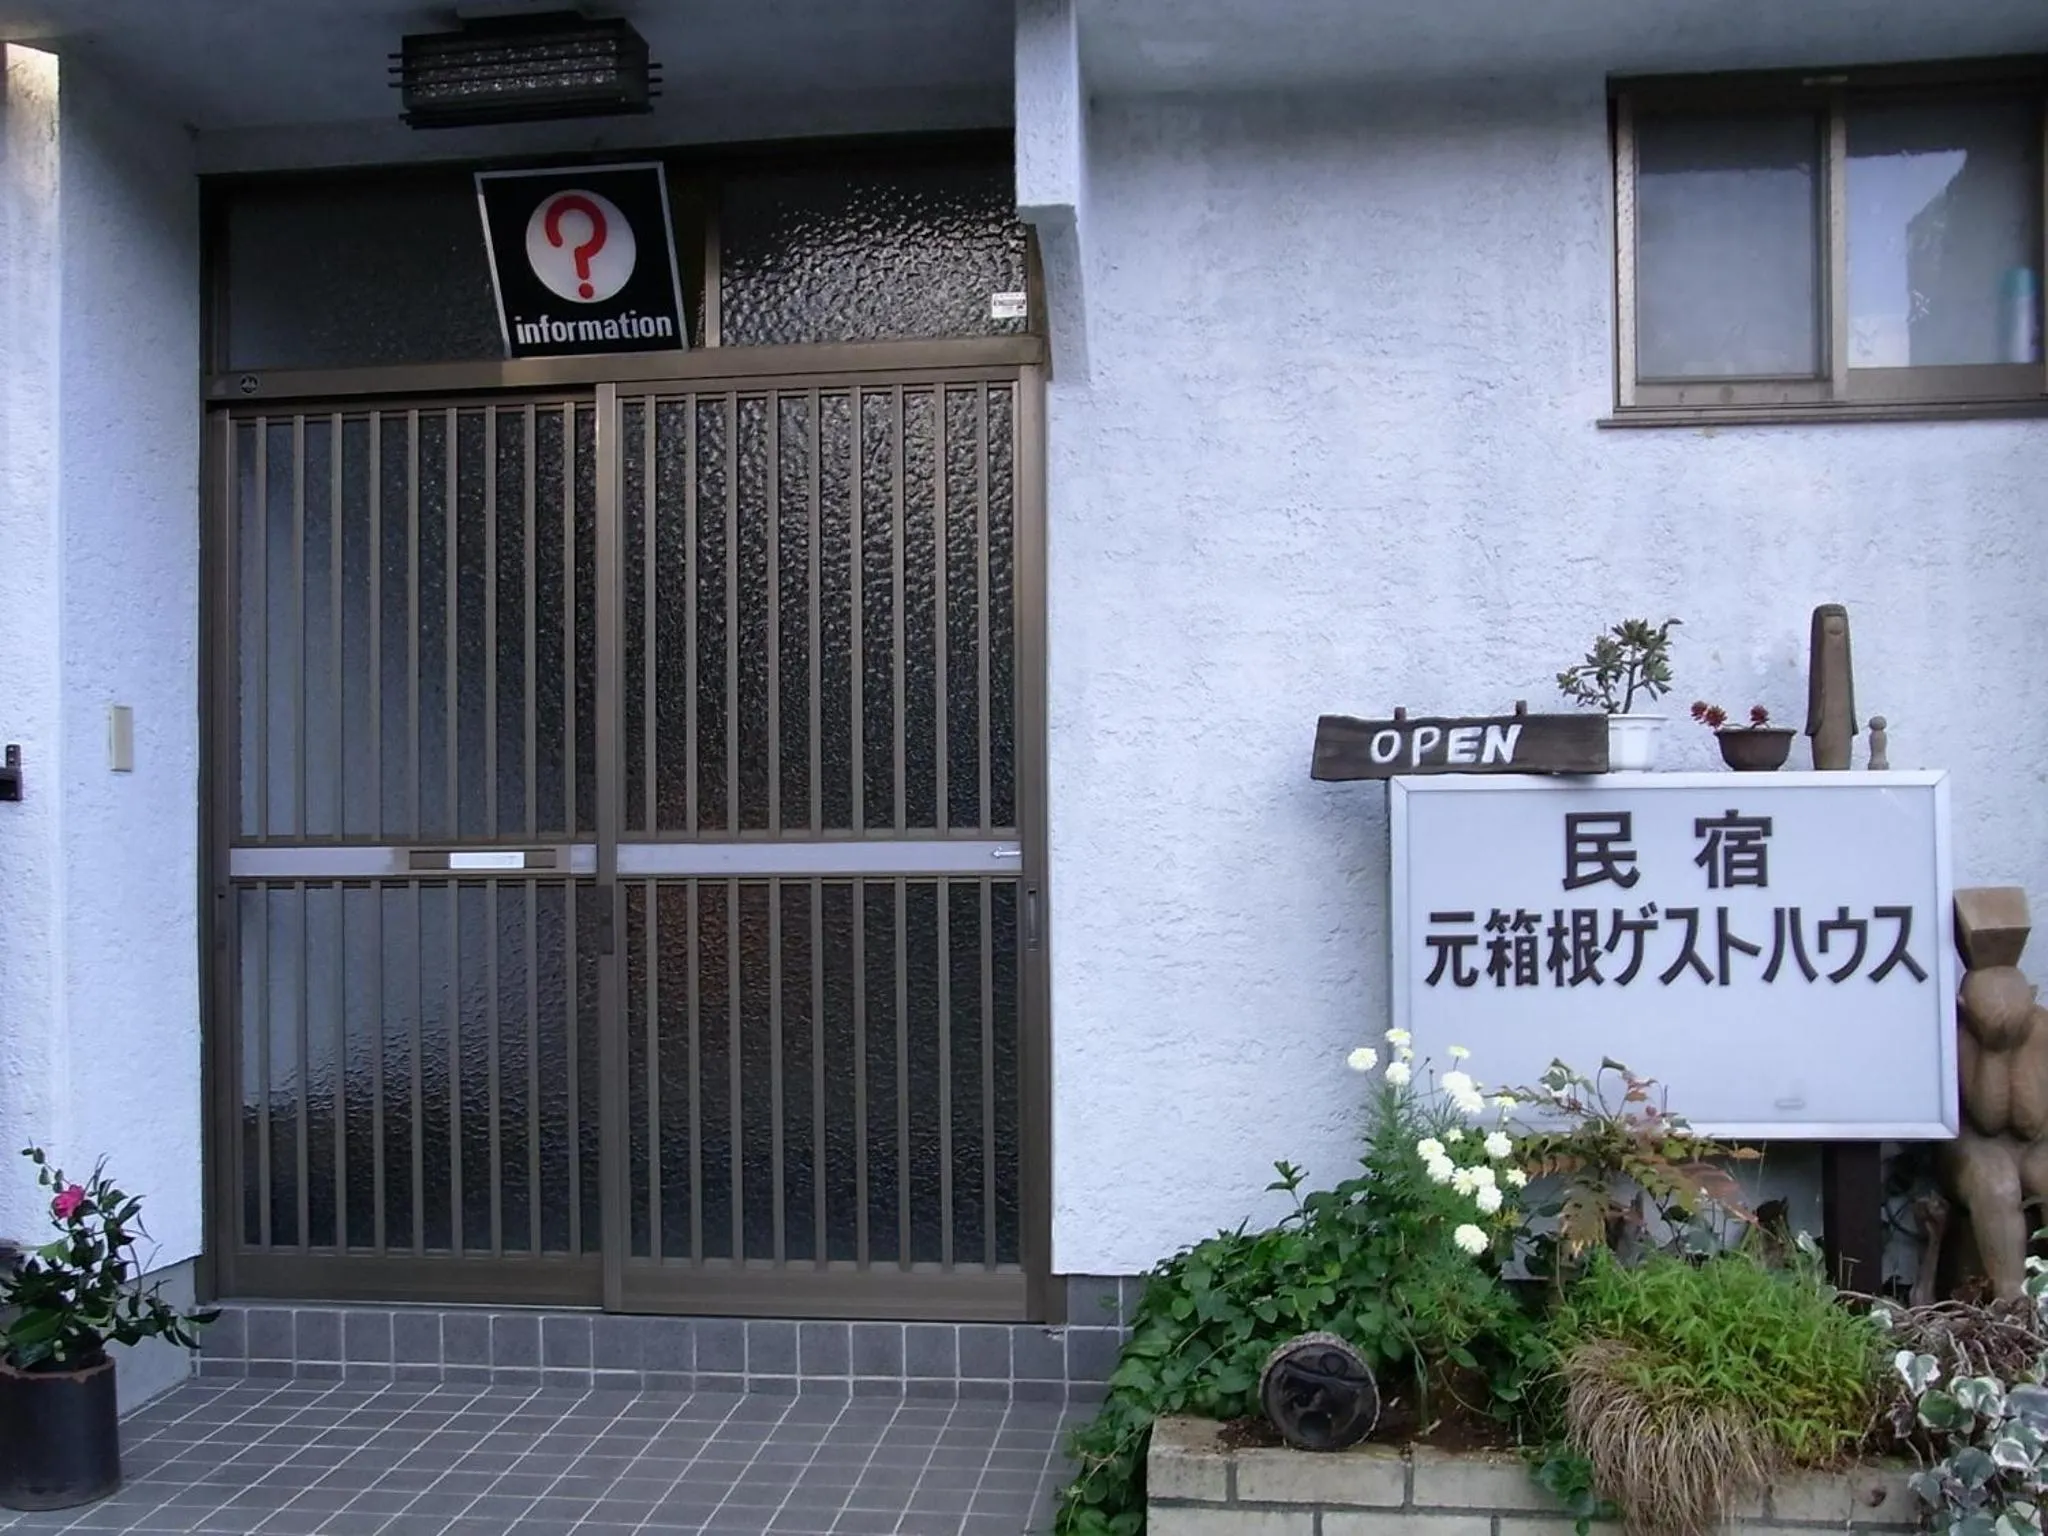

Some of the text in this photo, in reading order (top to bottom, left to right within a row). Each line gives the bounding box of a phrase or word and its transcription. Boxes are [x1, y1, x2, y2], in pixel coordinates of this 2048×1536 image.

[514, 310, 673, 344] information
[1370, 724, 1523, 767] OPEN
[1562, 809, 1773, 892] 民宿
[1424, 901, 1929, 988] 元箱根ゲストハウス
